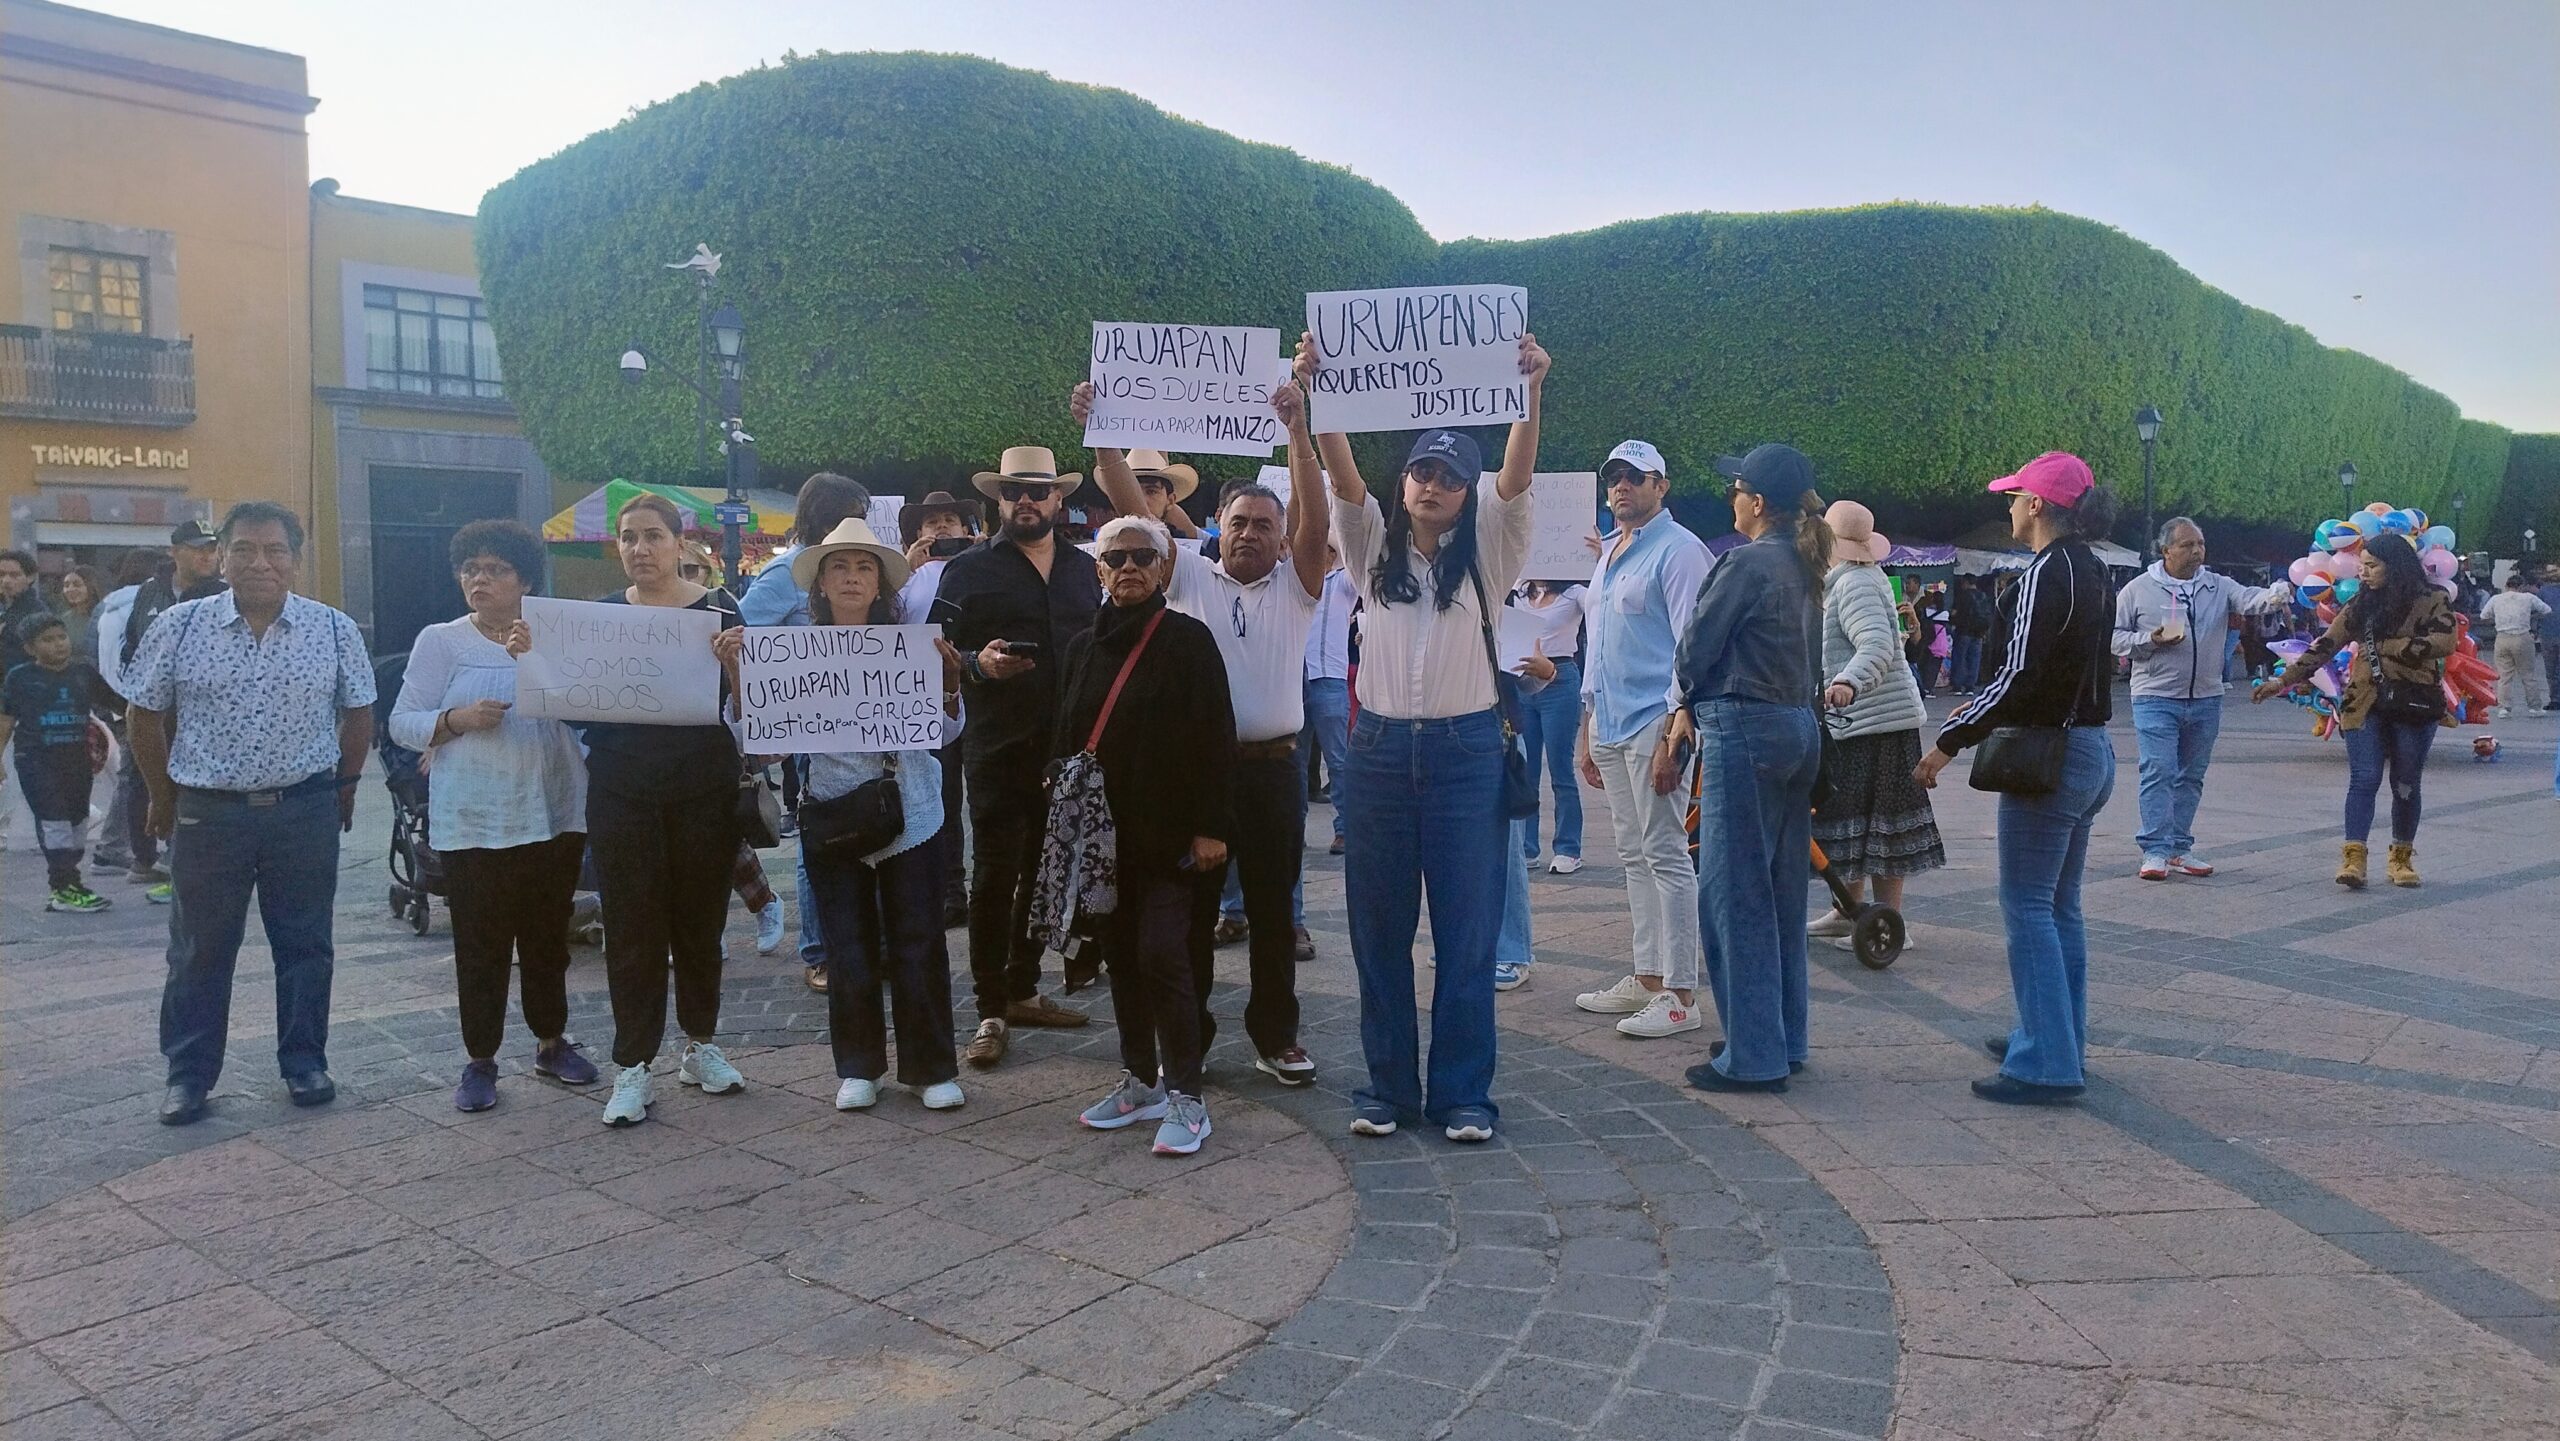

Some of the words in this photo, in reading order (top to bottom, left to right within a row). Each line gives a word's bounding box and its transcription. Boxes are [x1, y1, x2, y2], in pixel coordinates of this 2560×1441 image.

[1317, 292, 1525, 358] URUAPENSES
[1093, 326, 1248, 376] URUAPAN
[1410, 383, 1526, 419] JUSTICIA!
[536, 609, 682, 655] MICHOACÁN
[894, 632, 908, 660] A
[560, 657, 663, 679] SOMOS
[525, 684, 663, 712] TODOS
[747, 669, 850, 708] URUAPAN
[863, 670, 926, 697] MICH
[855, 698, 938, 720] CARLOS
[861, 720, 942, 747] MANZO
